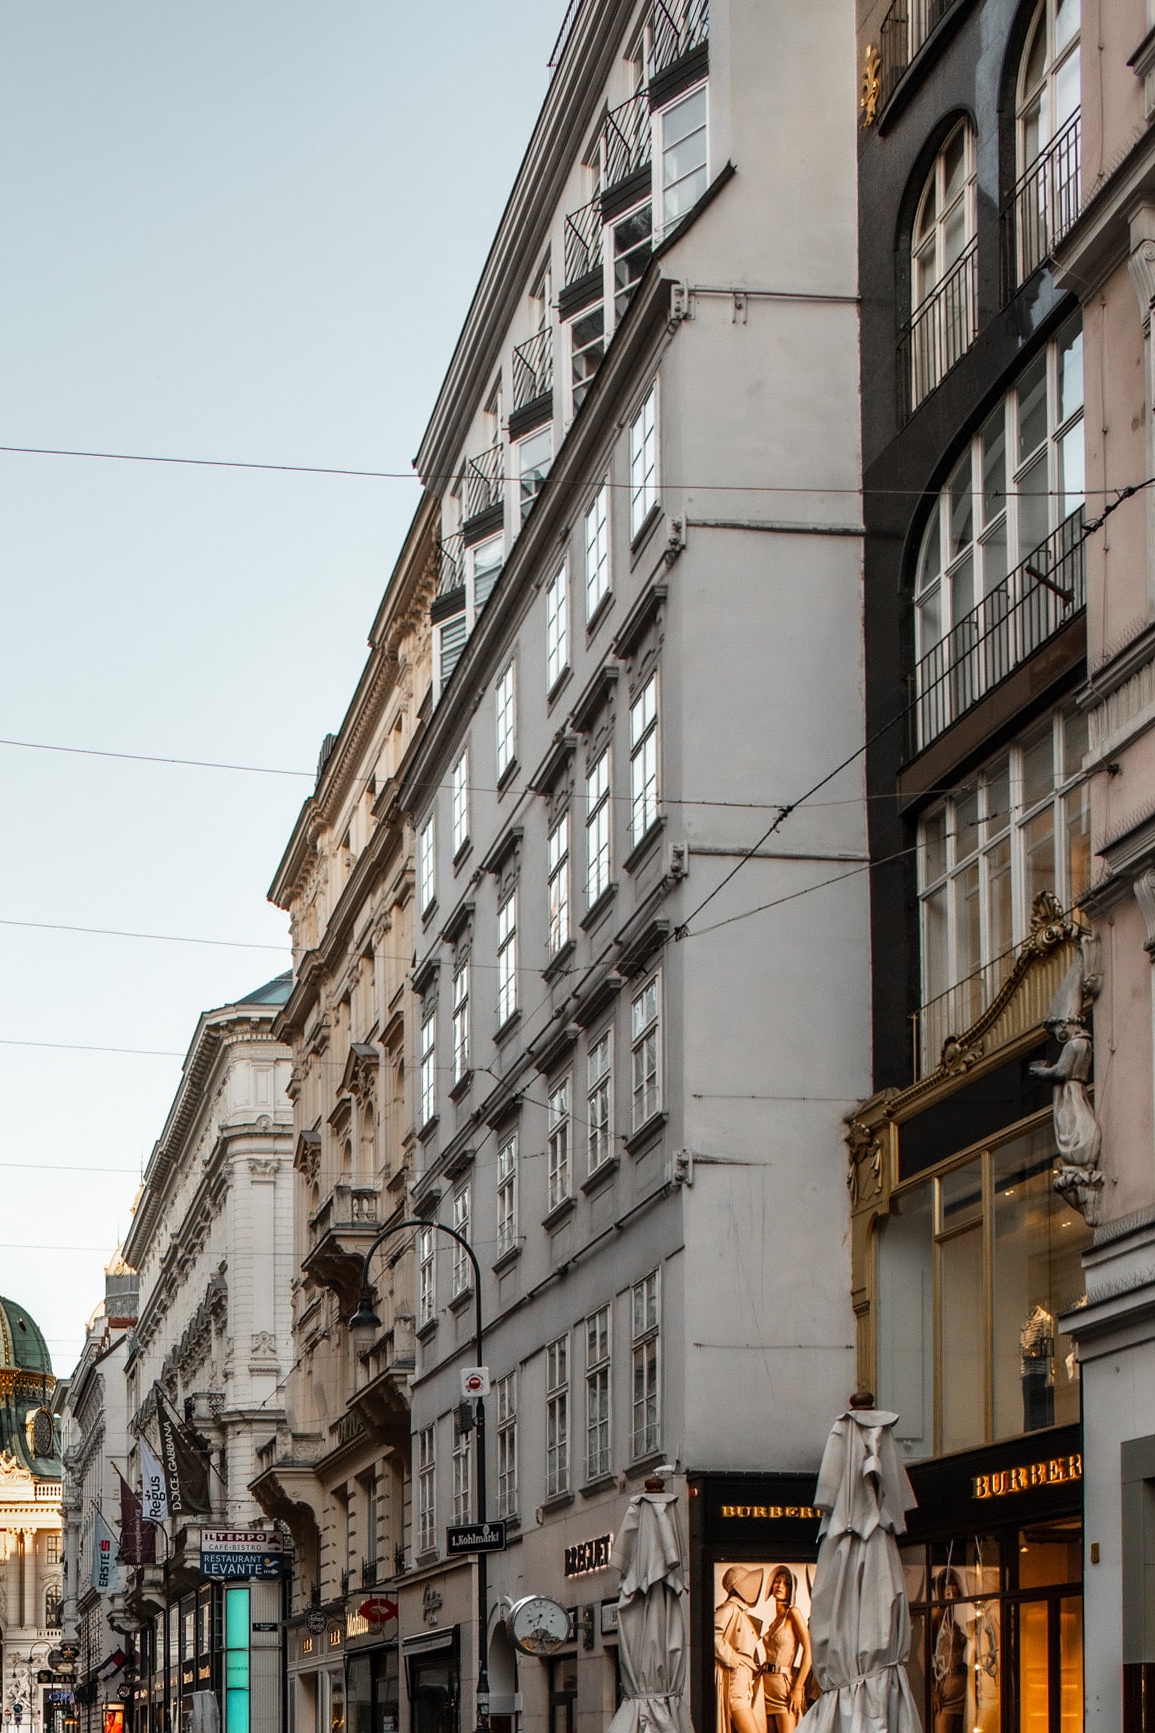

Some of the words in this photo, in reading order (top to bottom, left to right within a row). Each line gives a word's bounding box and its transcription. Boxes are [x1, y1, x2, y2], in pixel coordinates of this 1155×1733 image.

[149, 1475, 166, 1518] Regus
[217, 1533, 265, 1541] TEMPO
[203, 1554, 262, 1564] RESTAURANT
[98, 1553, 111, 1588] ERSTE
[203, 1563, 263, 1575] LEVANTE
